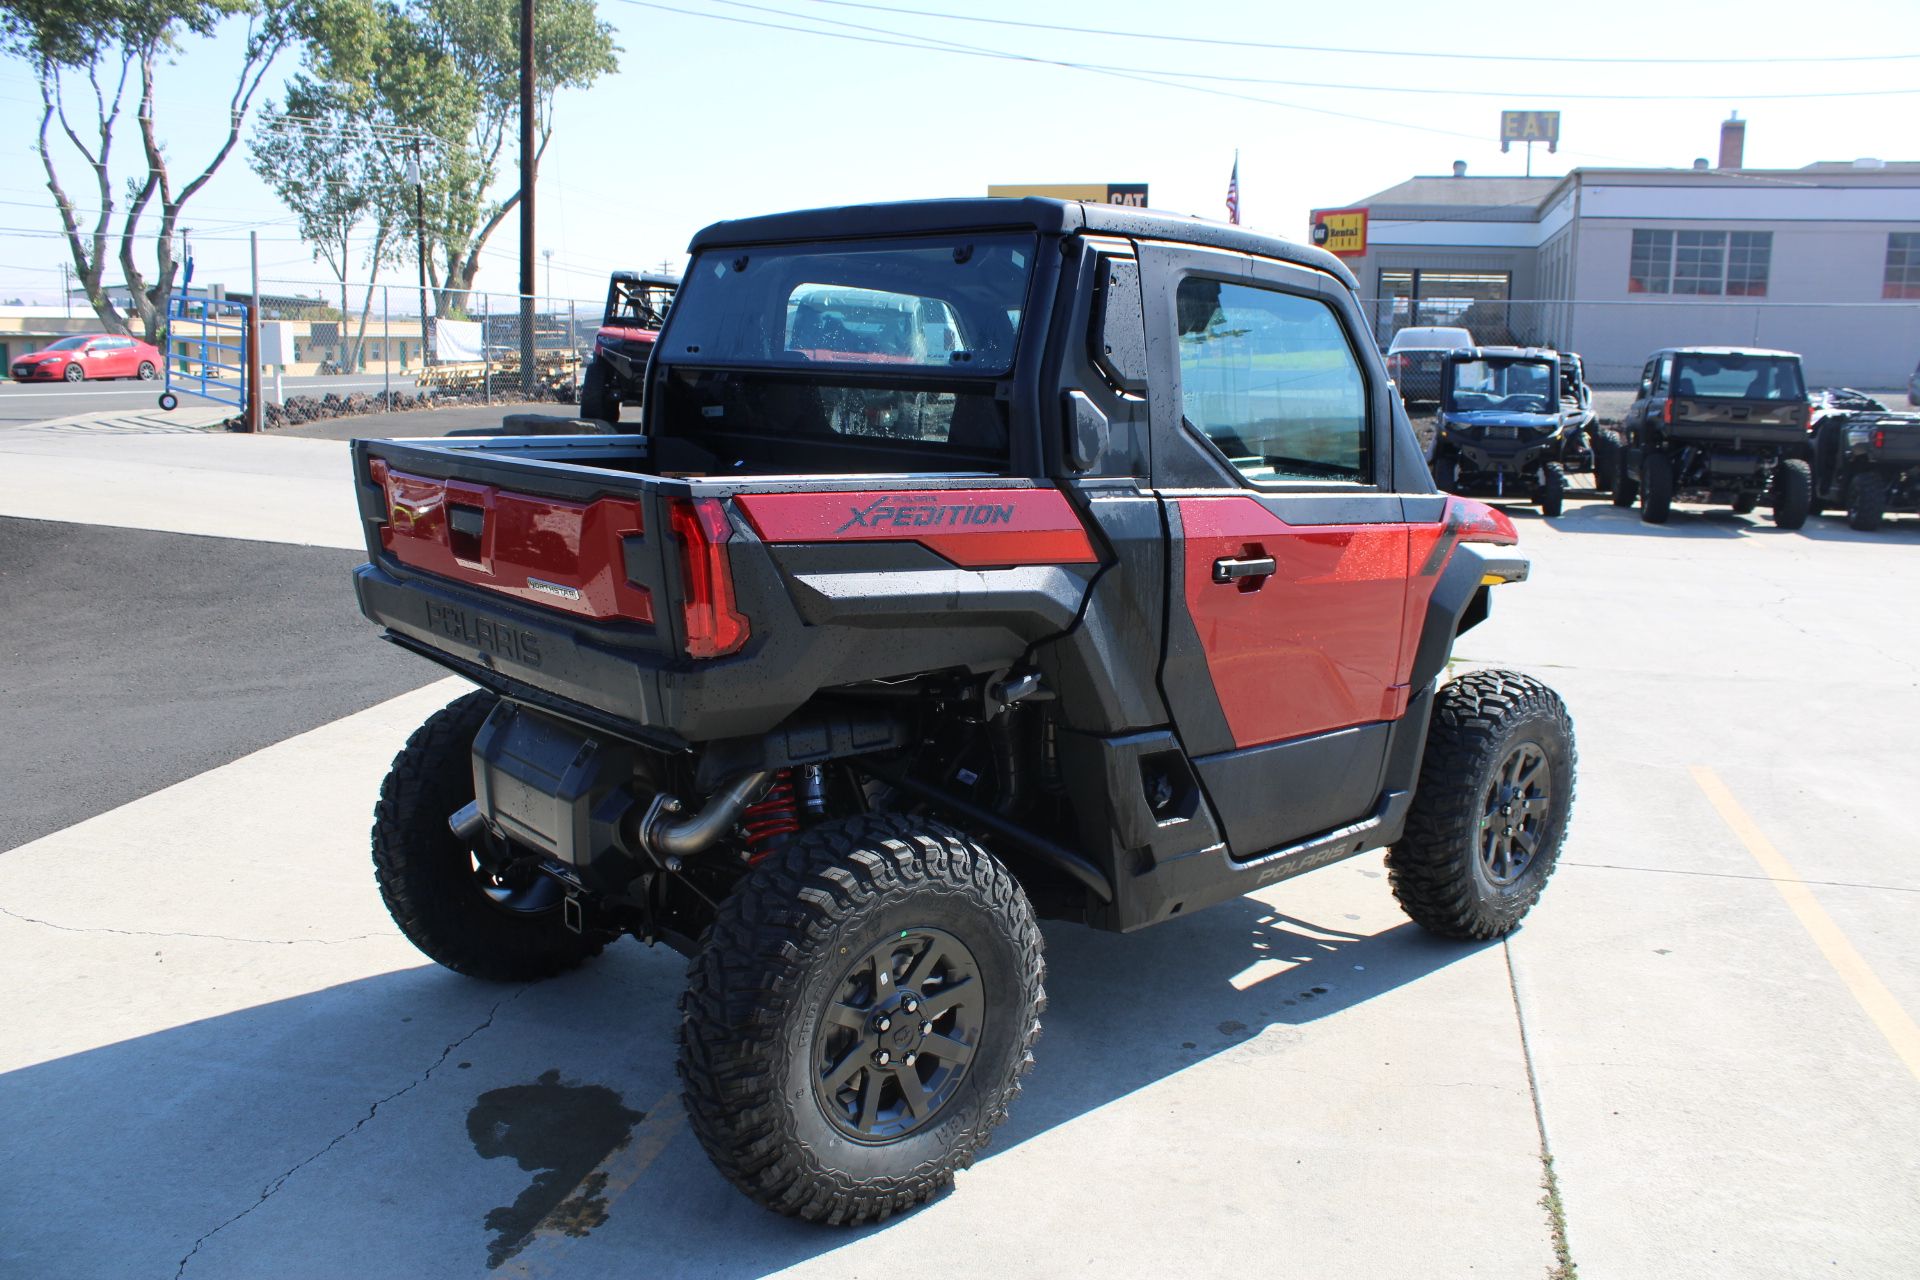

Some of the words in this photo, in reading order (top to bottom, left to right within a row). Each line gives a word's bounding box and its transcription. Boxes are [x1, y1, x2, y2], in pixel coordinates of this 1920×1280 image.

[1504, 112, 1558, 137] EAT
[1111, 193, 1144, 207] CAT
[1330, 227, 1358, 237] Rental
[891, 495, 938, 503] POLARIS
[833, 496, 1016, 534] XPEDITION
[425, 600, 541, 667] POLARIS
[1256, 843, 1348, 884] POLARIS
